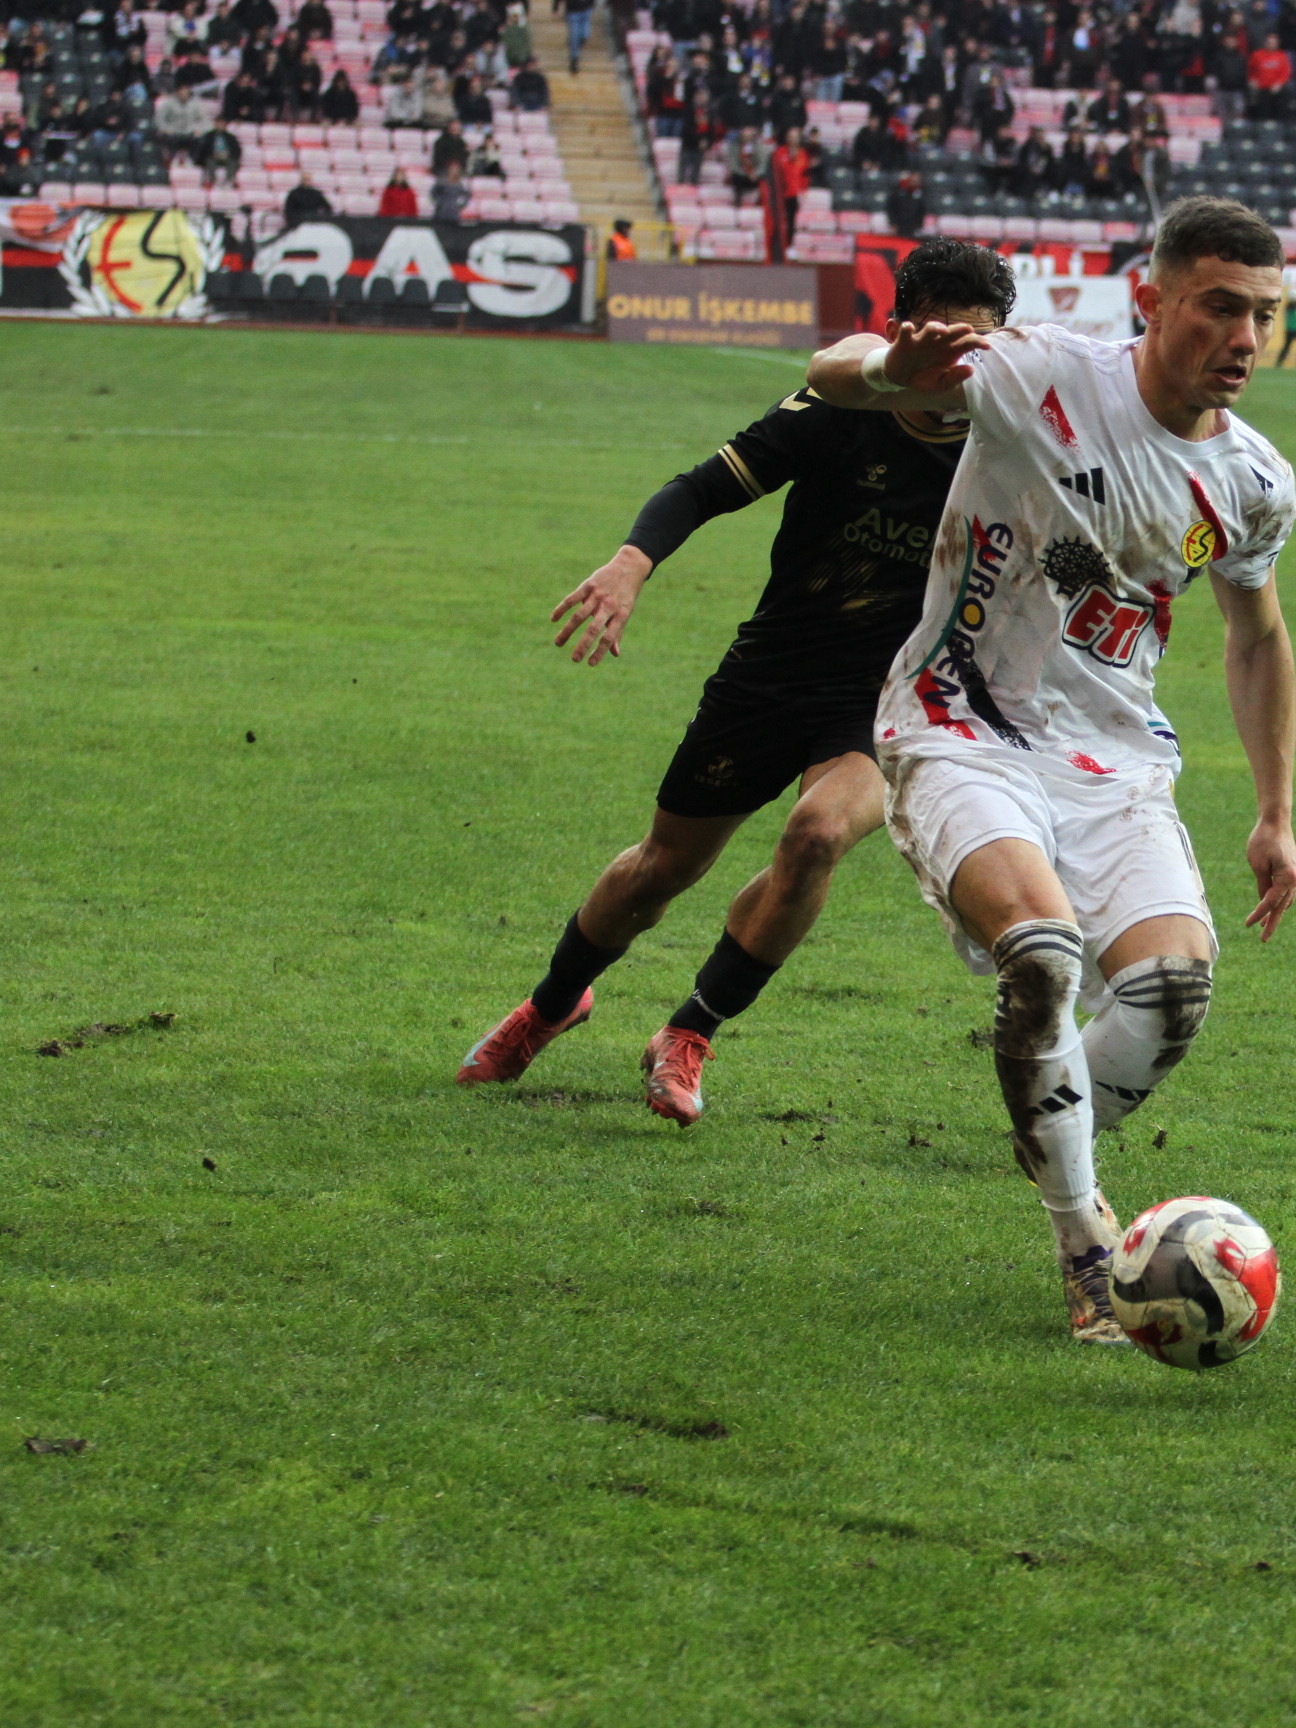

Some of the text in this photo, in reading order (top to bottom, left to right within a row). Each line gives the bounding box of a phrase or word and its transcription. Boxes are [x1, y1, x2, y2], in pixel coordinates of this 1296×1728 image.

[607, 294, 691, 321] ONUR
[843, 522, 931, 569] Otomot
[853, 507, 937, 550] Ave
